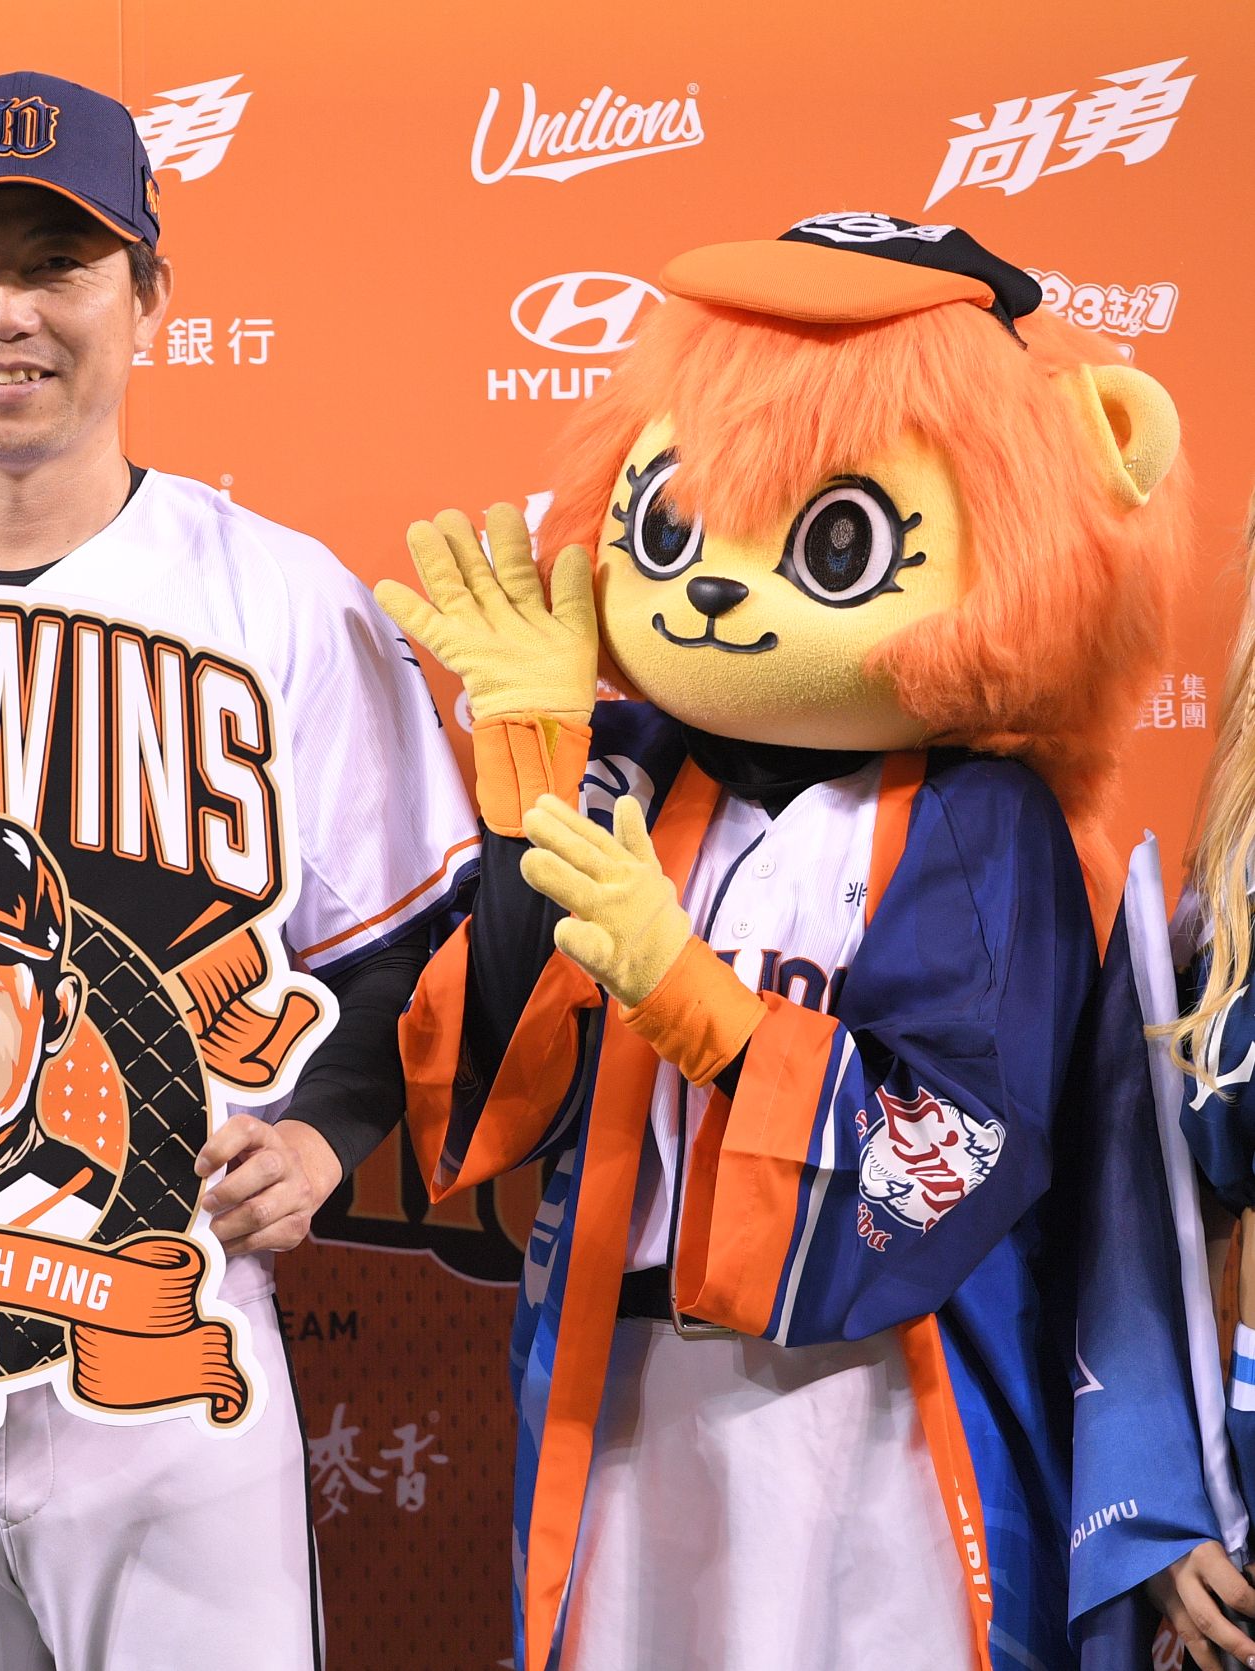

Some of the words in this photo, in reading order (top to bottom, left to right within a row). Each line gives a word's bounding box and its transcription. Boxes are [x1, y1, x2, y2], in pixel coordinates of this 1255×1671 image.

[471, 83, 704, 184] Unilions
[922, 57, 1197, 212] 尚勇
[132, 317, 275, 366] 銀行
[26, 1255, 113, 1311] PING
[281, 1310, 358, 1341] EAM
